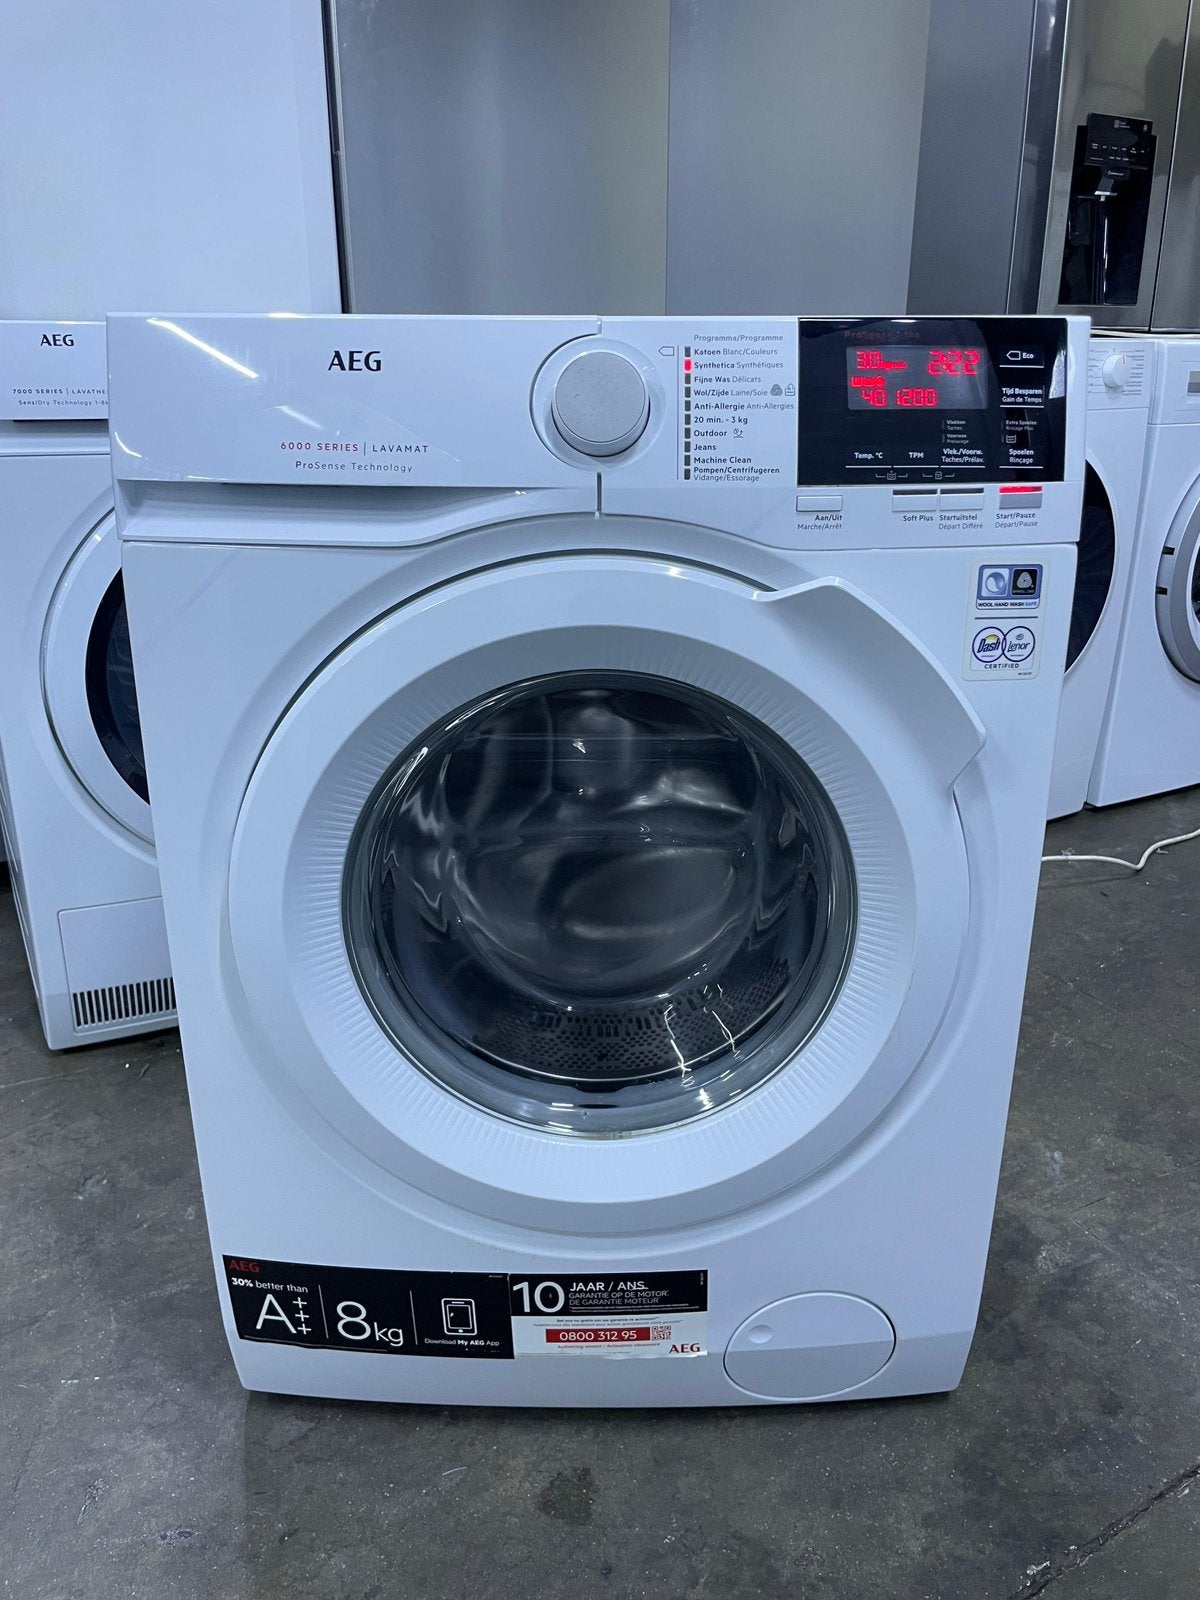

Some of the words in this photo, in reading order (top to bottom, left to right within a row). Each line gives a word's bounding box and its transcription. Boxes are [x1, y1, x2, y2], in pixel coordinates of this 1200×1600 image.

[40, 334, 74, 346] AEG
[694, 334, 784, 342] Programma/Programme
[328, 350, 382, 372] AEG
[928, 350, 980, 375] 2:22
[694, 389, 729, 397] Wol/Zijde
[862, 389, 886, 406] 40
[896, 388, 937, 406] 1200
[280, 442, 311, 450] 6000
[317, 443, 358, 452] SERIES
[372, 444, 429, 453] LAVAMAT
[295, 461, 346, 470] ProSense
[351, 462, 412, 472] Technology
[798, 522, 842, 530] Marche/Arrêt
[977, 638, 1000, 653] Dash
[1007, 641, 1030, 652] Lenor
[228, 1260, 260, 1273] AEG
[232, 1277, 254, 1288] 30%
[255, 1281, 284, 1292] better
[287, 1283, 308, 1293] than
[570, 1282, 605, 1292] JAAR
[512, 1281, 565, 1313] 10
[560, 1332, 594, 1340] 0800
[598, 1331, 618, 1340] 312
[622, 1331, 637, 1340] 95
[669, 1343, 700, 1354] AEG
